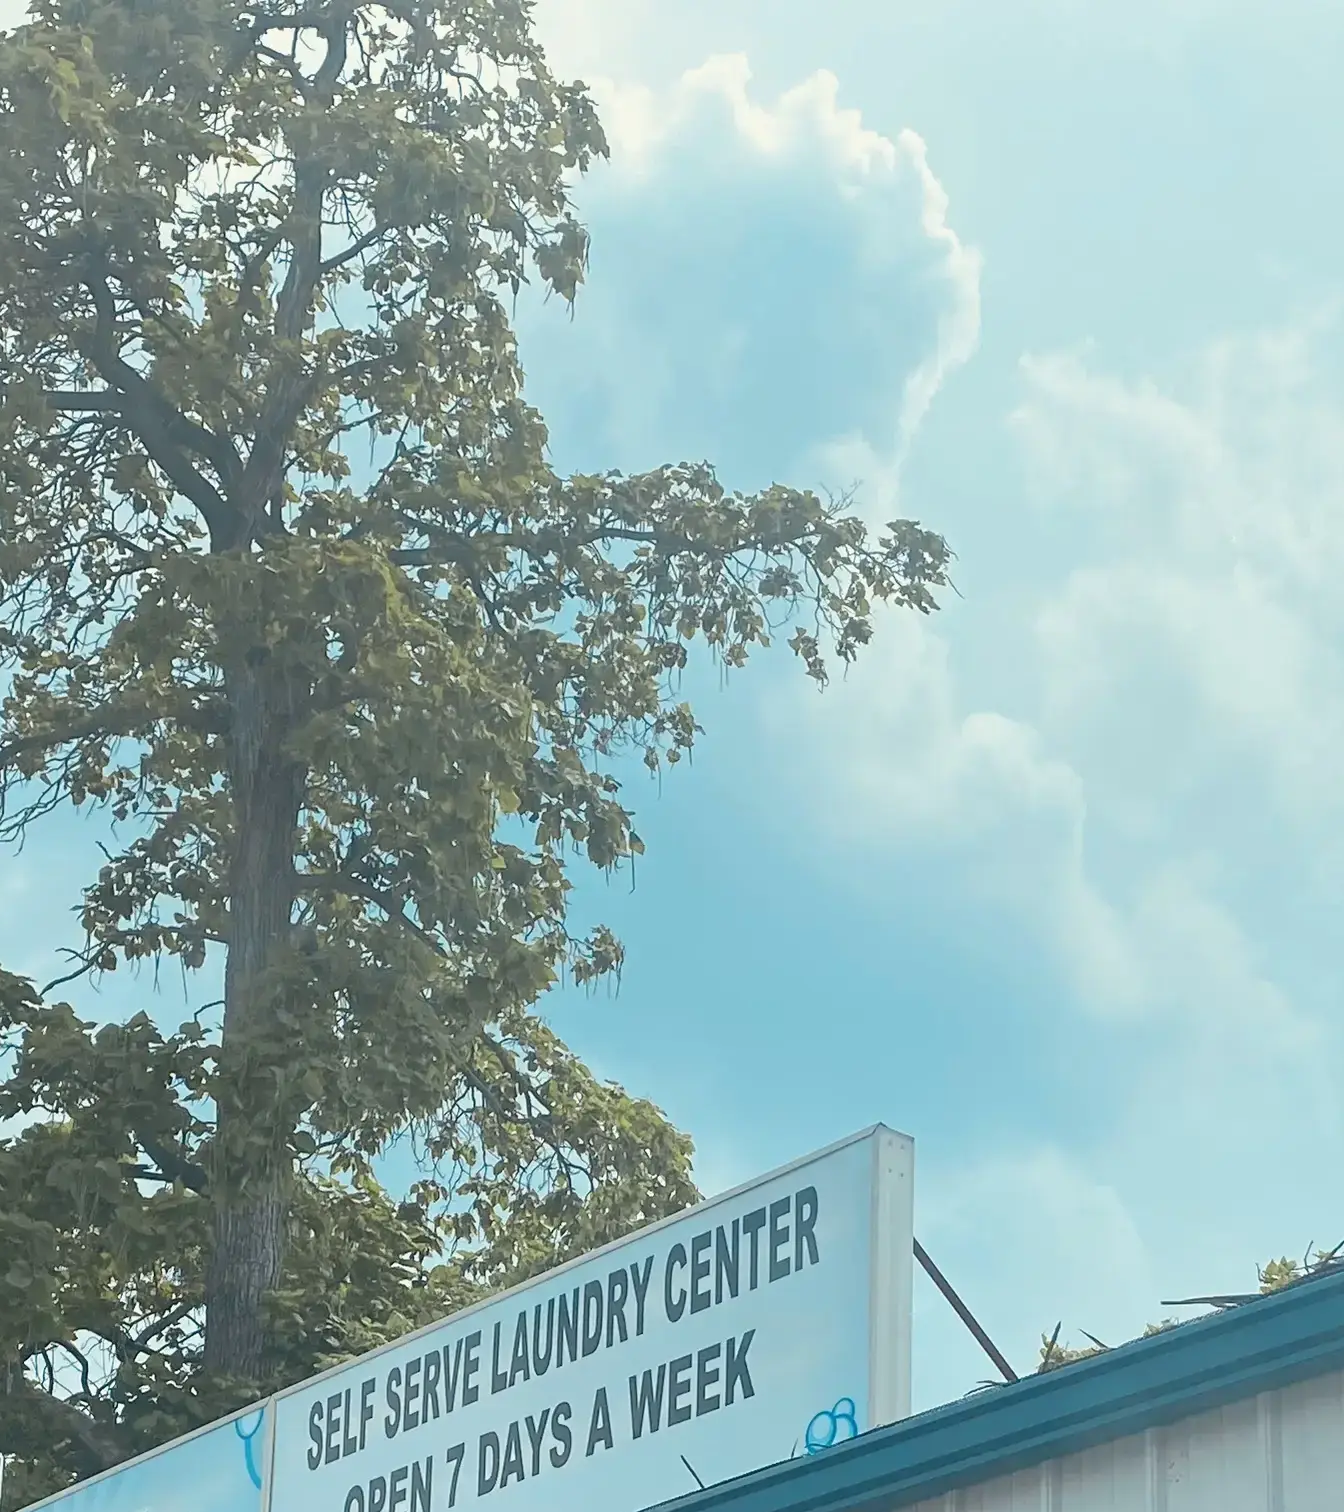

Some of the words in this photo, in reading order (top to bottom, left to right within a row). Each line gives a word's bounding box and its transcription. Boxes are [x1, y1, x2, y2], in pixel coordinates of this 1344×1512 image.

[307, 1377, 376, 1471] SELF
[384, 1330, 482, 1440] SERVE
[490, 1255, 655, 1395] LAUNDRY
[663, 1185, 820, 1324] CENTER
[446, 1442, 466, 1508] 7
[477, 1401, 573, 1498] DAYS
[585, 1386, 614, 1457] A
[628, 1328, 756, 1440] WEEK
